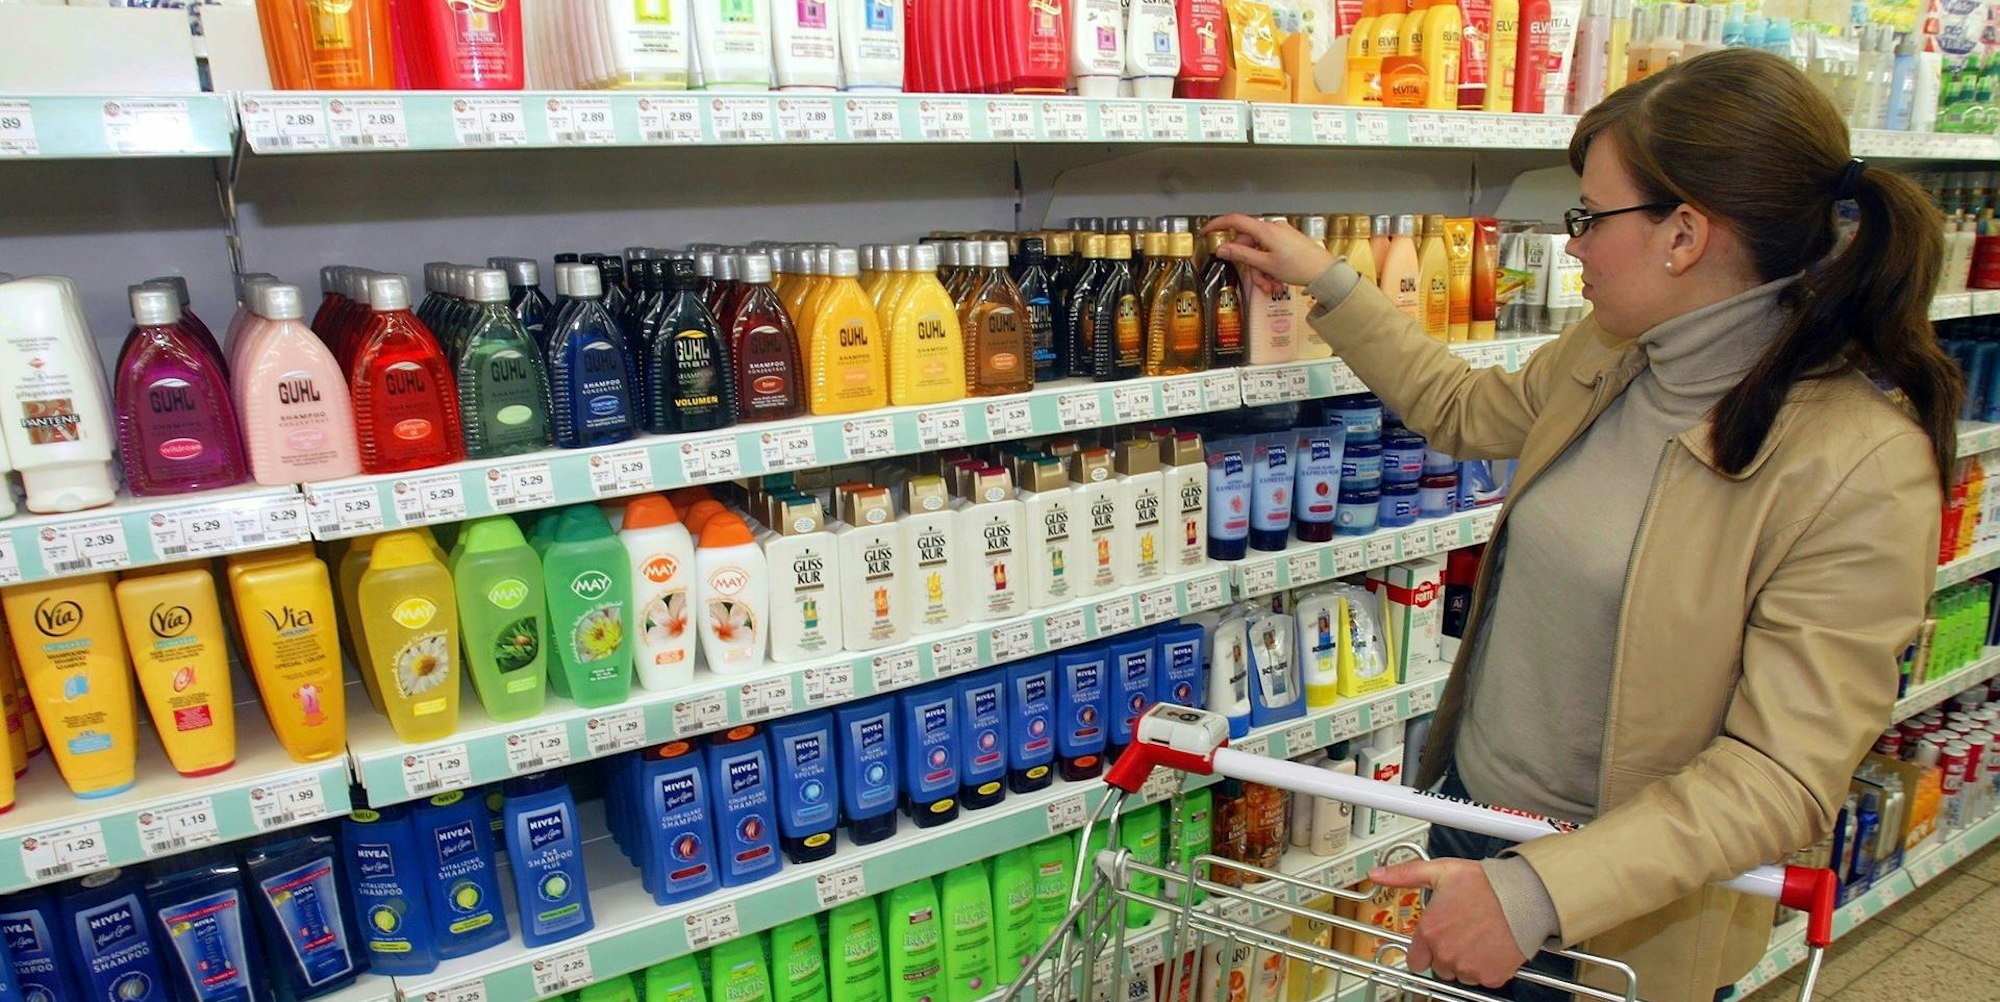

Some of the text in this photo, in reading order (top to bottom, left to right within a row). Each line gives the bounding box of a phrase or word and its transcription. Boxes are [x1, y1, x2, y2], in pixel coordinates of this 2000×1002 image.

[286, 114, 314, 126] 2.89
[368, 113, 395, 125] 2.89
[489, 112, 515, 123] 2.89
[580, 112, 604, 122] 2.89
[670, 111, 692, 122] 2.89
[742, 111, 763, 121] 2.89
[805, 112, 826, 121] 2.89
[873, 112, 893, 121] 2.89
[945, 112, 963, 122] 2.89
[1011, 112, 1029, 122] 2.89
[1064, 113, 1081, 122] 2.89
[1121, 113, 1138, 123] 4.29
[1167, 114, 1183, 124] 4.29
[1219, 115, 1233, 125] 4.29
[1272, 118, 1287, 127] 1.02
[1401, 278, 1416, 292] GUHL
[1176, 297, 1198, 313] GUHL
[989, 314, 1016, 333] GUHL
[918, 321, 946, 340] GUHL
[839, 327, 868, 347] GUHL
[674, 339, 710, 361] GUHL
[584, 351, 616, 373] GUHL
[678, 360, 709, 368] man
[749, 361, 784, 369] SHAMPOO
[491, 360, 526, 382] GUHL
[385, 371, 425, 395] GUHL
[583, 378, 621, 389] SHAMPOO
[1259, 379, 1273, 387] 5.79
[278, 379, 320, 404] GUHL
[1181, 388, 1196, 397] 5.79
[151, 388, 195, 413] GUHL
[675, 396, 718, 407] VOLUMEN
[1134, 395, 1150, 404] 5.79
[1079, 402, 1095, 411] 5.29
[280, 412, 326, 420] SHAMPOO
[1009, 410, 1025, 420] 5.29
[21, 414, 81, 429] PANTENE
[942, 419, 960, 429] 5.29
[869, 427, 888, 439] 5.29
[788, 438, 809, 450] 5.29
[1312, 440, 1329, 449] NIVEA
[710, 448, 732, 459] 5.29
[1225, 454, 1242, 464] NIVEA
[621, 461, 644, 473] 5.29
[519, 474, 545, 487] 5.29
[429, 487, 455, 500] 5.29
[1181, 486, 1202, 499] GLISS
[345, 499, 371, 512] 5.29
[1136, 496, 1158, 511] GLISS
[1183, 497, 1200, 508] KUR
[1091, 502, 1114, 516] GLISS
[1138, 508, 1156, 521] KUR
[269, 509, 298, 522] 5.29
[1045, 511, 1068, 526] GLISS
[1094, 514, 1112, 527] KUR
[192, 520, 220, 532] 5.29
[984, 524, 1010, 539] GLISS
[1048, 523, 1066, 536] KUR
[84, 533, 114, 547] 2.39
[918, 535, 946, 550] GLISS
[988, 536, 1008, 550] KUR
[864, 548, 892, 563] GLISS
[921, 547, 943, 560] KUR
[645, 563, 678, 578] MAY
[794, 558, 823, 572] GLISS
[868, 561, 890, 574] KUR
[798, 571, 821, 585] KUR
[1261, 570, 1274, 579] 3.79
[575, 579, 609, 592] MAY
[714, 573, 747, 589] MAY
[494, 587, 523, 600] MAY
[1203, 584, 1217, 593] 2.39
[1158, 596, 1172, 605] 2.39
[1115, 606, 1130, 617] 2.39
[42, 608, 76, 629] Via
[157, 612, 185, 631] Via
[263, 606, 314, 631] Via
[1066, 619, 1080, 629] 2.39
[1013, 632, 1028, 642] 2.39
[956, 646, 972, 656] 2.39
[1174, 647, 1191, 655] NIVEA
[896, 660, 913, 670] 2.39
[1128, 658, 1145, 666] NIVEA
[1077, 669, 1096, 677] NIVEA
[830, 674, 847, 684] 2.39
[1027, 681, 1045, 689] NIVEA
[767, 689, 786, 698] 1.29
[976, 693, 995, 702] NIVEA
[701, 704, 721, 714] 1.29
[925, 708, 945, 718] NIVEA
[617, 721, 638, 732] 1.29
[862, 723, 882, 734] NIVEA
[539, 738, 561, 749] 1.29
[796, 740, 818, 750] NIVEA
[438, 759, 460, 771] 1.29
[731, 763, 758, 774] NIVEA
[664, 779, 692, 792] NIVEA
[289, 789, 313, 803] 1.99
[438, 794, 457, 802] NEU
[729, 796, 767, 811] SHAMPOO
[354, 811, 373, 819] NEU
[1067, 805, 1081, 814] 2.25
[179, 813, 206, 827] 1.19
[530, 817, 561, 830] NIVEA
[662, 814, 682, 822] COLOR
[662, 814, 703, 829] SHAMPOO
[438, 827, 471, 841] NIVEA
[65, 838, 94, 852] 1.29
[358, 850, 388, 858] NIVEA
[528, 851, 572, 868] SHAMPOO
[441, 857, 479, 871] VITALIZING
[544, 862, 561, 870] PLUS
[438, 862, 484, 880] SHAMPOO
[841, 875, 858, 885] 2.25
[359, 888, 403, 896] SHAMPOO
[91, 911, 130, 928] NIVEA
[194, 918, 215, 927] NIVEA
[712, 915, 730, 926] 2.25
[3, 924, 34, 934] IVEA
[93, 947, 149, 973] SHAMPOO
[564, 960, 584, 972] 2.25
[458, 992, 479, 1002] 2.25
